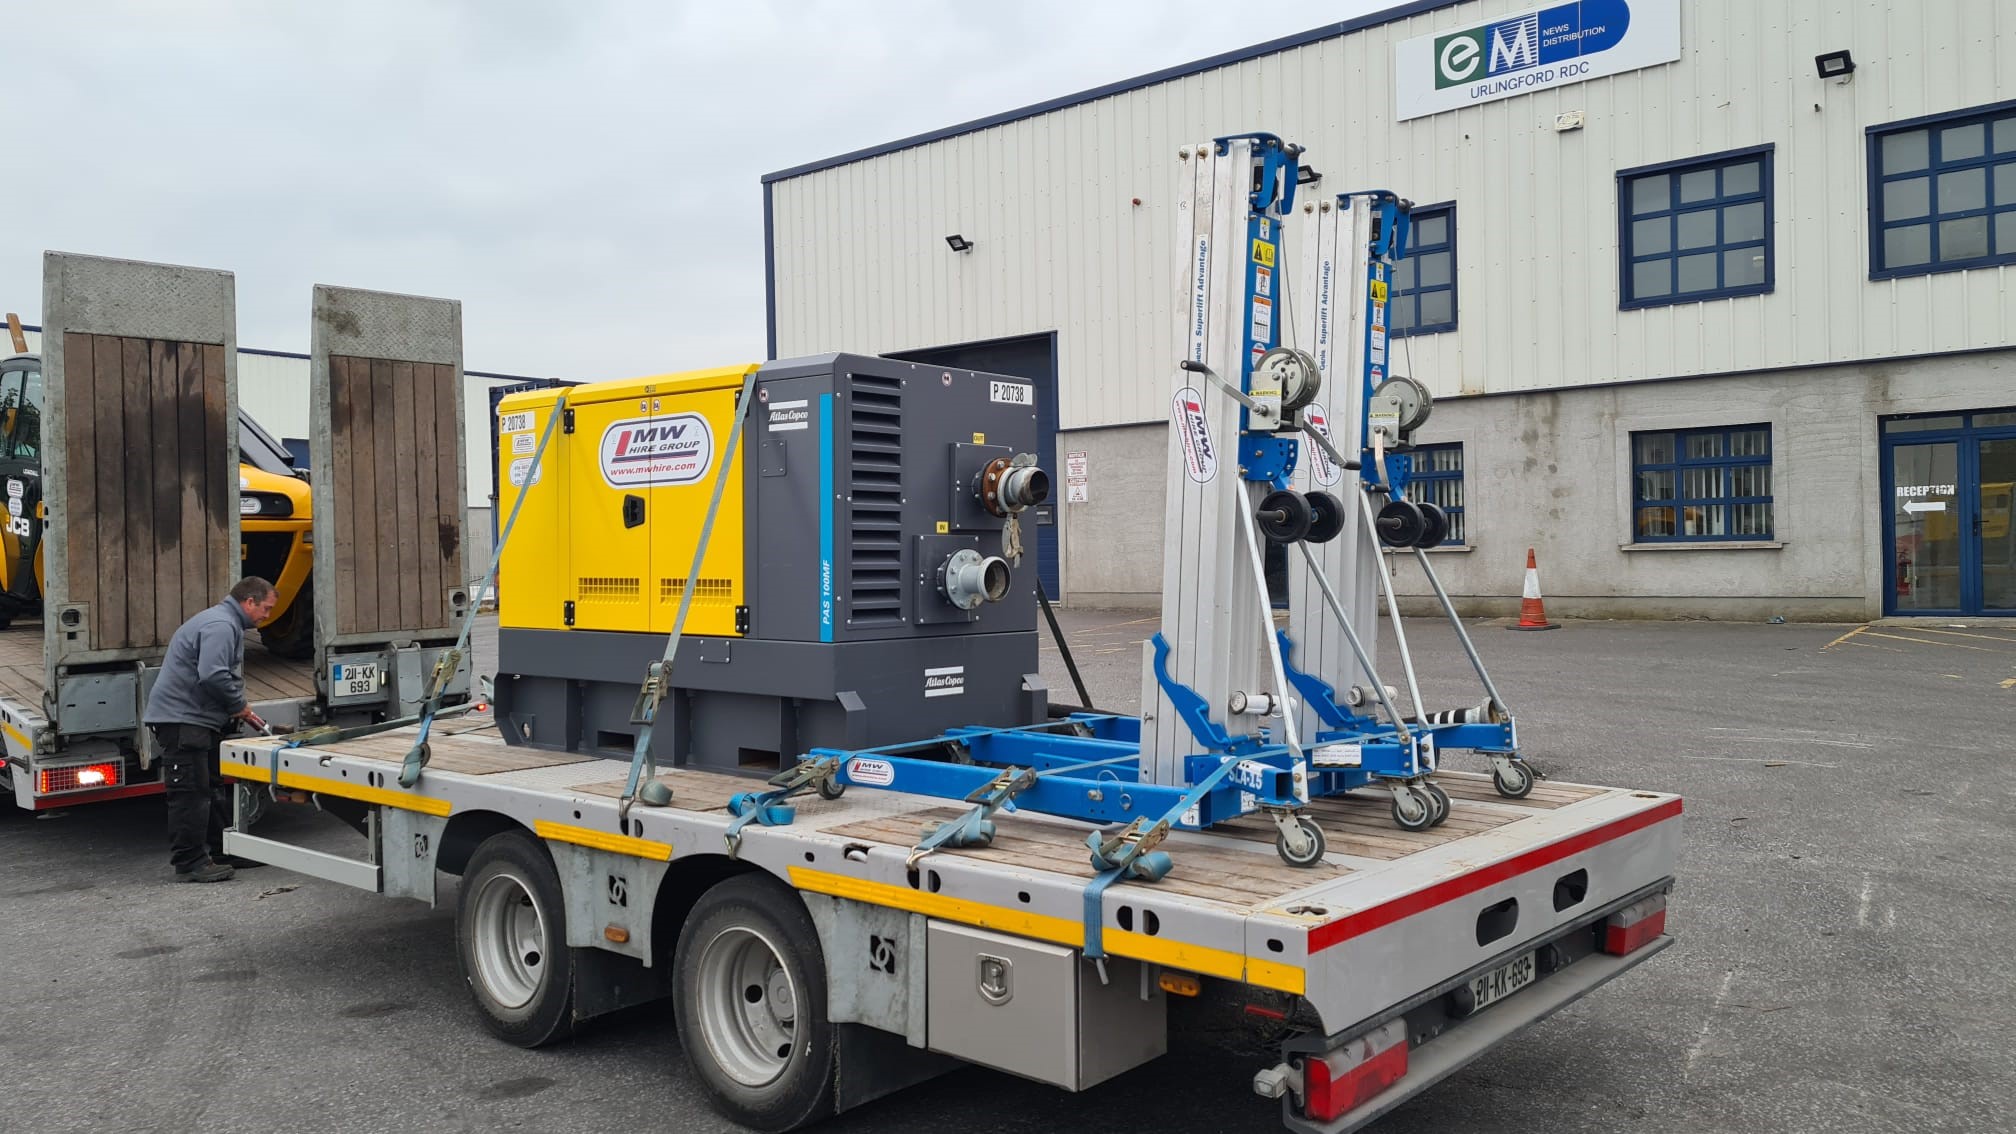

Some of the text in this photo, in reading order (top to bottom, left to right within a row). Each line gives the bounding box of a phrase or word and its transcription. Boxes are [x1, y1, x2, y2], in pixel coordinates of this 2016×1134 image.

[1543, 23, 1569, 37] NEWS
[1543, 25, 1606, 48] DISTRIBUTION
[1470, 61, 1590, 99] URLINGFORD RDC
[1197, 240, 1207, 291] Advantage
[1321, 260, 1331, 306] Advantage
[1195, 293, 1204, 337] Superlift
[1320, 307, 1329, 345] Superlift
[993, 383, 1024, 402] P 20738
[501, 414, 526, 432] P 20738
[768, 410, 808, 422] Atlas Copco
[633, 424, 687, 444] MW
[1195, 415, 1213, 460] MW
[629, 440, 700, 454] HIRE GROUP
[610, 462, 697, 476] www.mwhire.com
[1896, 484, 1955, 497] RECEPTION
[6, 515, 30, 537] JCB
[822, 559, 831, 625] PAS 100MF
[345, 666, 376, 680] 211-KK
[925, 675, 964, 688] Atlas Copco
[350, 680, 370, 693] 693
[1228, 767, 1263, 790] SLA-15
[1476, 956, 1530, 1006] 211-KK-693
